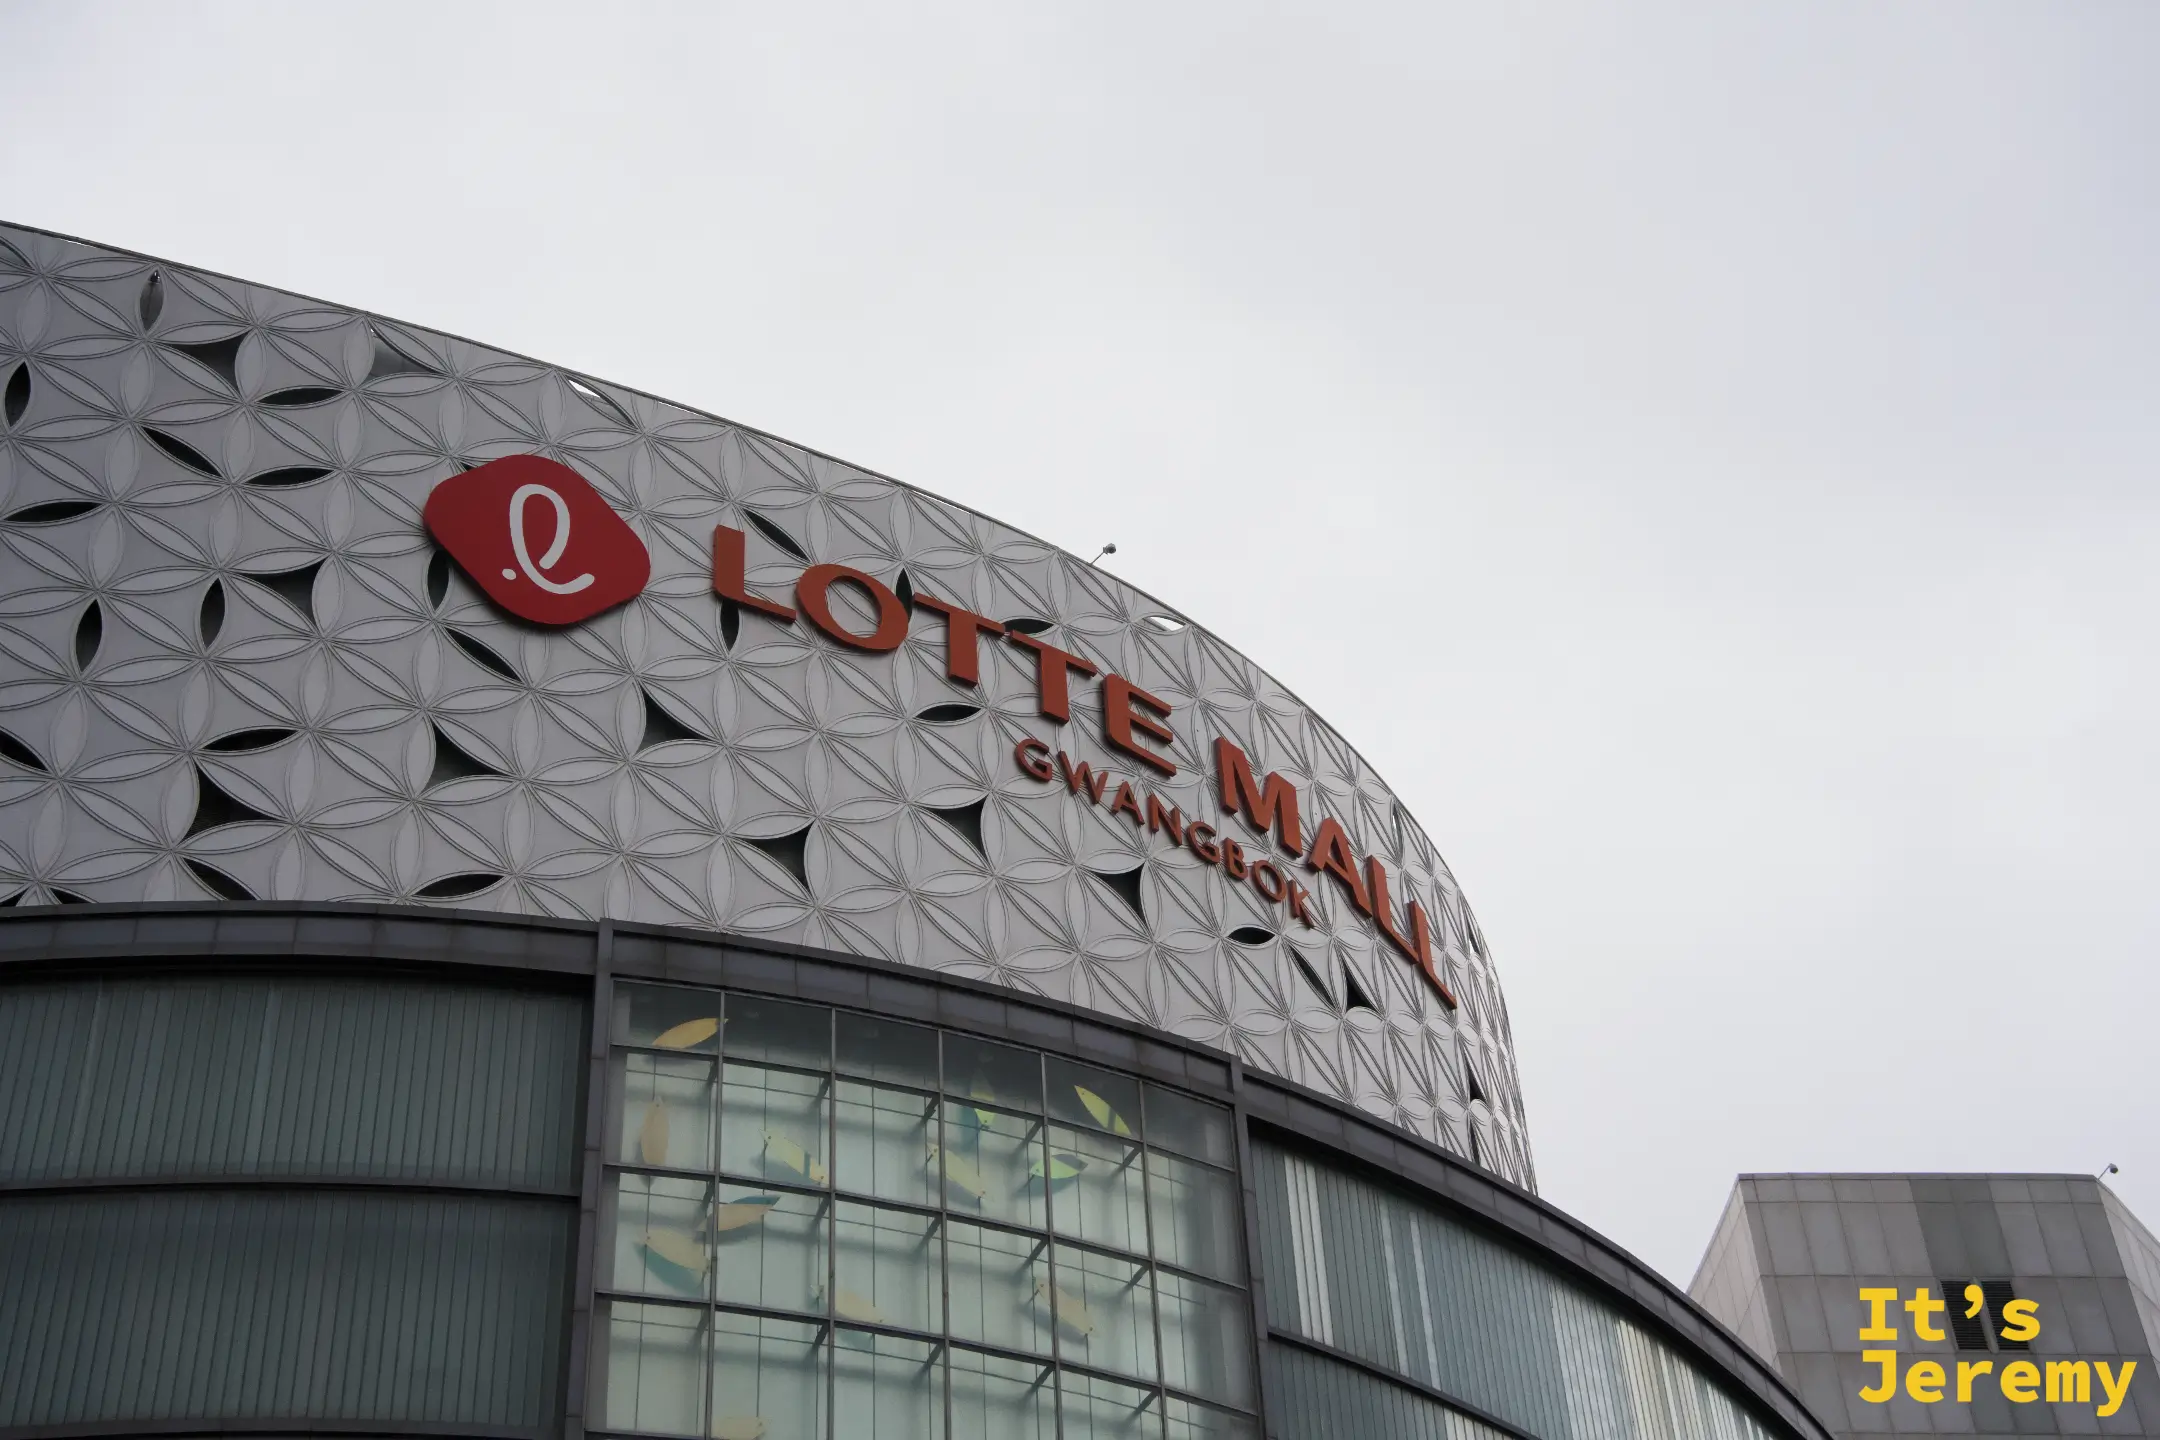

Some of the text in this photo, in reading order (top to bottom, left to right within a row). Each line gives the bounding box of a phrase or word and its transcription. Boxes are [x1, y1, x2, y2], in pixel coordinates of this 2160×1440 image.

[713, 525, 1457, 1009] LOTTE MALL
[1014, 738, 1314, 929] GWANGBOK
